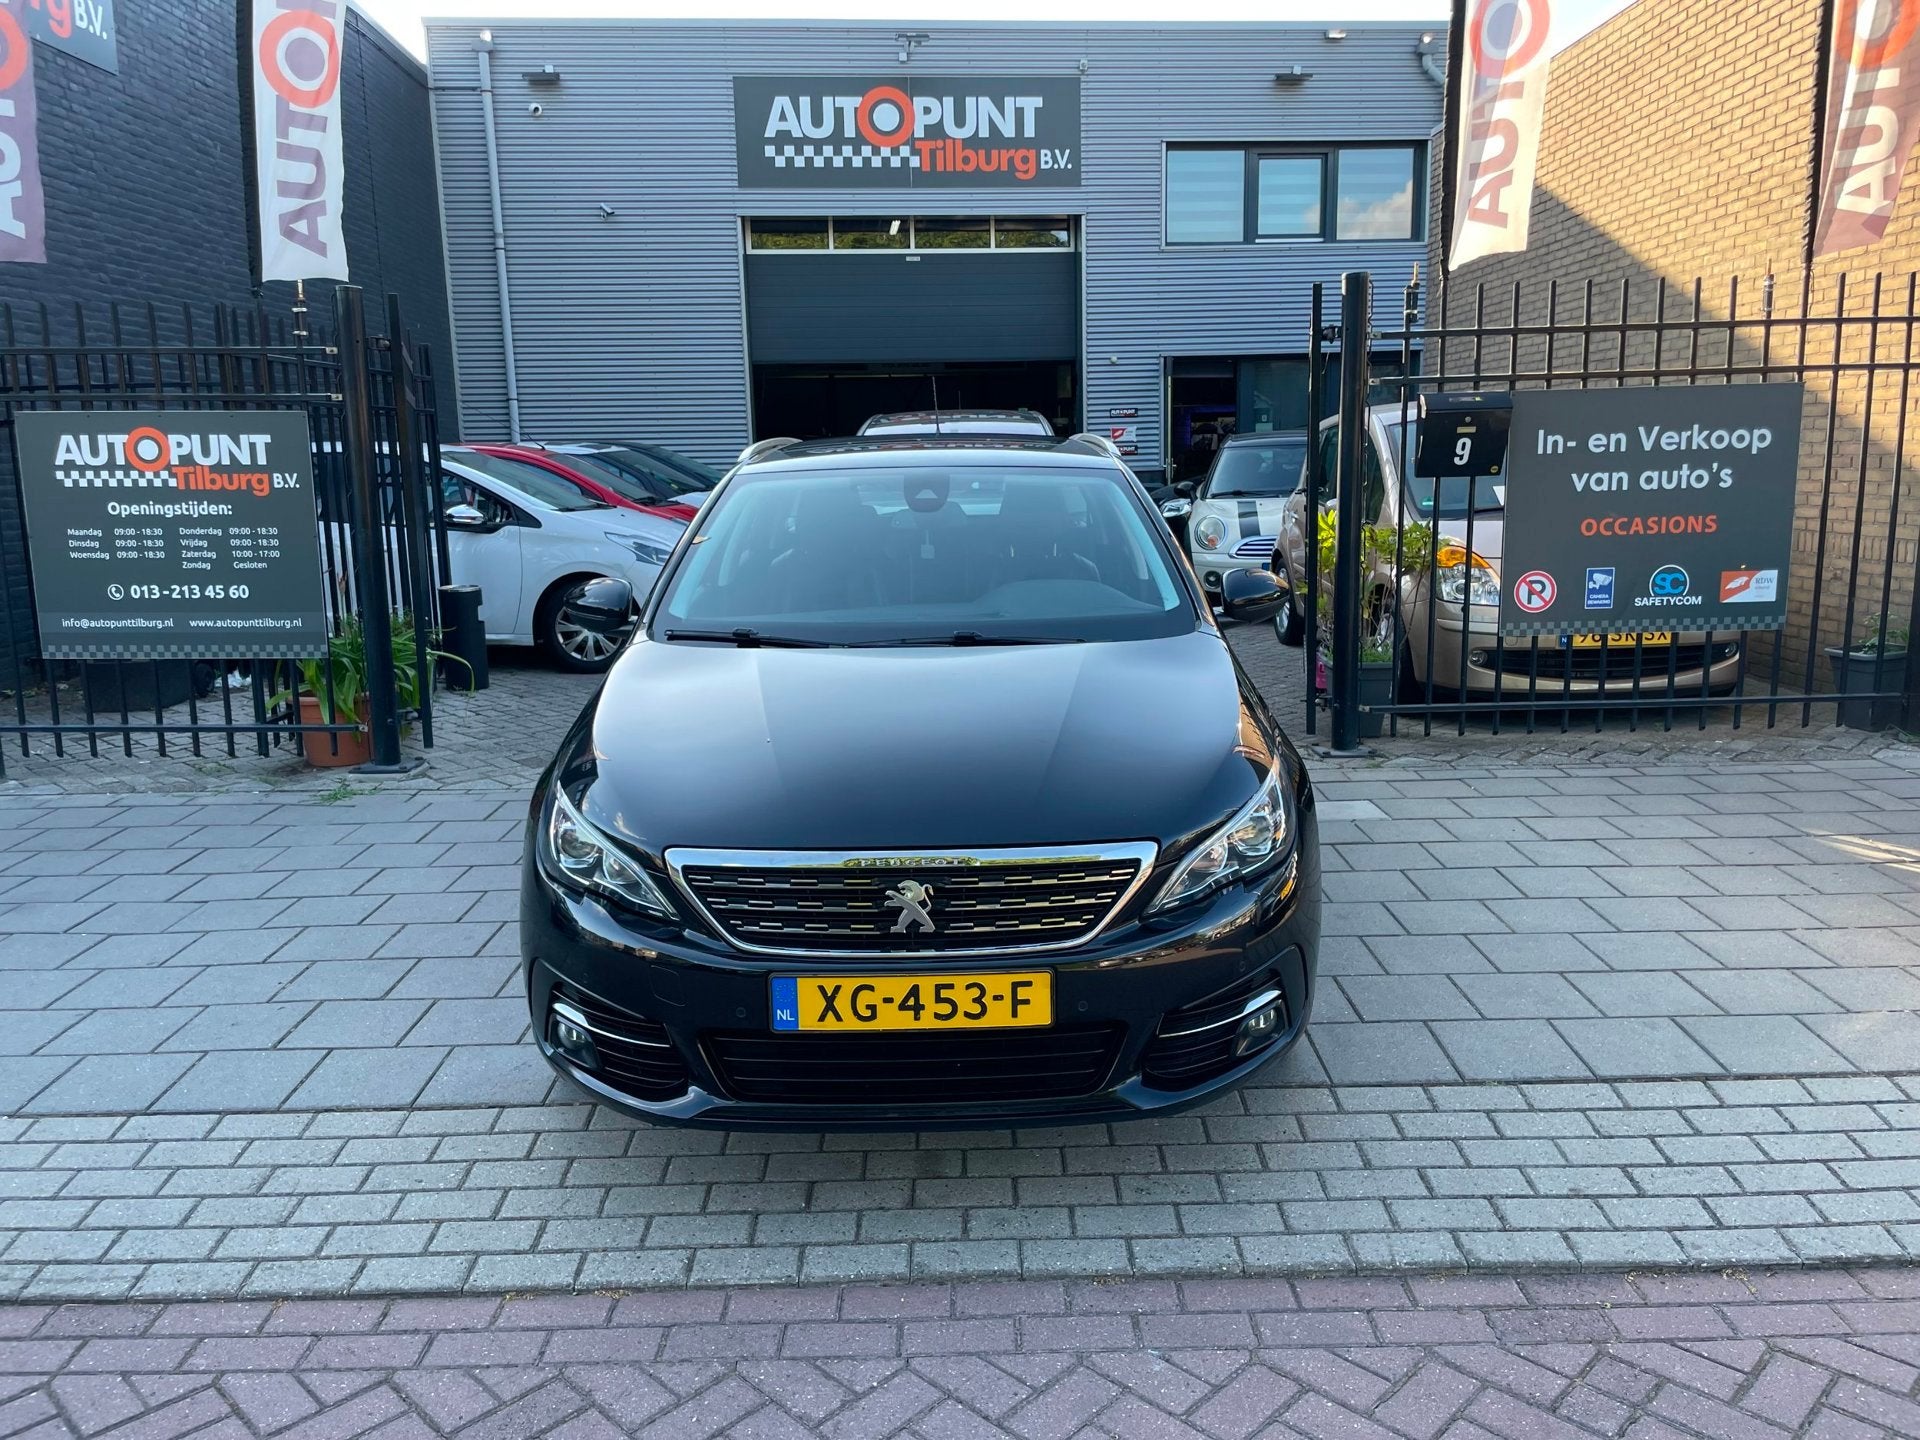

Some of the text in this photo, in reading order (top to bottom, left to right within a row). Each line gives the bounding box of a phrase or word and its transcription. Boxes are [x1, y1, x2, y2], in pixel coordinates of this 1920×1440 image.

[764, 86, 1043, 148] AUTOPUNT
[914, 139, 1073, 180] Tilburg B.V.
[1537, 424, 1773, 455] In- en Verkoop
[55, 426, 271, 472] AUTOPUNT
[1453, 437, 1472, 466] 9
[171, 466, 300, 497] Tilburg B.V.
[1571, 462, 1733, 492] van auto's
[107, 501, 233, 518] Openingstijden:
[179, 527, 223, 537] Donderdag
[229, 527, 251, 535] 09:00
[257, 527, 278, 535] 18:30
[1580, 514, 1718, 537] OCCASIONS
[67, 528, 103, 537] Maandag
[114, 528, 136, 536] 09:00
[142, 528, 163, 536] 18:30
[68, 540, 100, 549] Dinsdag
[180, 539, 208, 548] Vrijdag
[69, 551, 110, 560] Woensdag
[181, 550, 217, 559] Zaterdag
[232, 550, 253, 558] 10:00
[259, 550, 280, 558] 17:00
[182, 561, 268, 570] Zondag Gesloten
[204, 584, 225, 599] 45
[228, 584, 250, 599] 60
[1634, 596, 1702, 606] SAFETYCOM
[61, 617, 303, 628] info@autopunttilburg.nl www.autopunttilburg.nl
[860, 859, 964, 867] PEUGEOT
[816, 981, 1034, 1023] XG-453-F
[776, 1010, 796, 1021] NL
